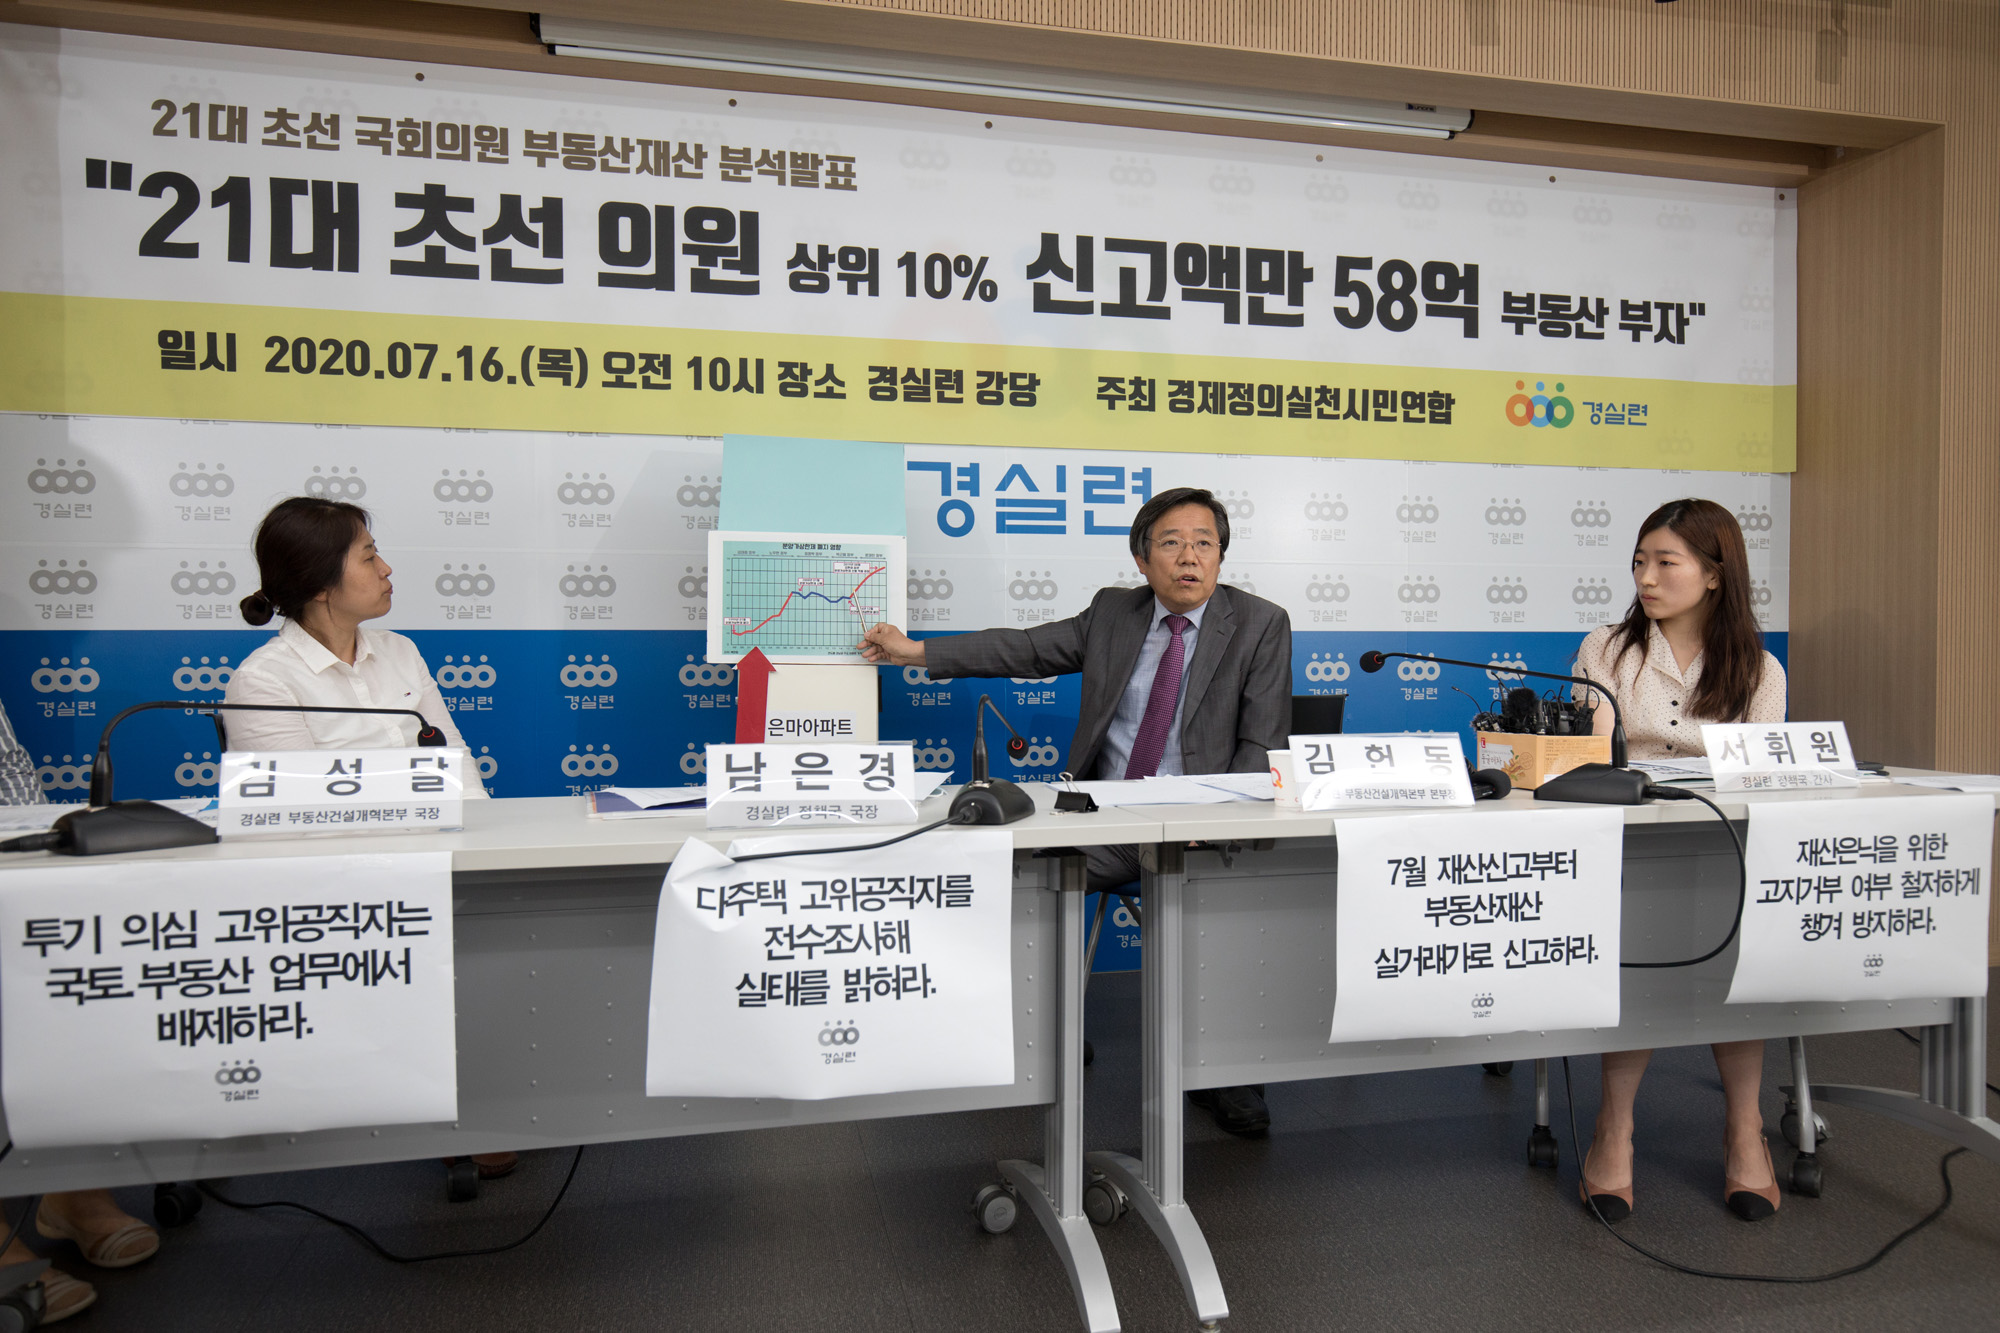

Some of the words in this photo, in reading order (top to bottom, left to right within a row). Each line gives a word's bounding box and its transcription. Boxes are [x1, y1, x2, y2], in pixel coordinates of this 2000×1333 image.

[150, 98, 249, 145] 21대
[261, 107, 343, 153] 초선
[354, 115, 510, 166] 국회의원
[522, 129, 708, 180] 부동산재산
[718, 145, 858, 192] 분석발표
[85, 157, 360, 274] "21대
[390, 182, 565, 285] 초선
[597, 200, 760, 296] 의원
[786, 241, 881, 297] 상위
[897, 250, 999, 303] 10%
[1025, 231, 1315, 329] 신고액만
[1333, 254, 1480, 340] 58억
[1500, 290, 1610, 341] 부동산
[1617, 298, 1706, 345] 부자"
[157, 328, 238, 373] 일시
[263, 334, 589, 388] 2020.07.16.(목)
[601, 350, 673, 391] 오전
[686, 356, 765, 396] 10시
[777, 361, 848, 400] 장소
[867, 364, 965, 405] 경실련
[975, 371, 1041, 408] 강당
[1096, 376, 1156, 414] 주최
[1167, 379, 1456, 425] 경제정의실천시민연합
[1581, 401, 1649, 427] 경실련
[907, 461, 1153, 538] 경실련
[33, 503, 93, 519] 경실련
[174, 505, 231, 521] 경실련
[438, 511, 490, 526] 경실련
[562, 513, 611, 528] 경실련
[1308, 528, 1346, 541] 경실련
[1400, 530, 1436, 543] 경실련
[1488, 532, 1524, 545] 경실련
[1574, 534, 1609, 546] 경실련
[35, 603, 94, 620] 경실련
[176, 604, 232, 620] 경실련
[440, 604, 492, 620] 경실련
[563, 605, 613, 620] 경실련
[907, 607, 951, 621] 경실련
[1012, 607, 1055, 621] 경실련
[1309, 610, 1347, 622] 경실련
[1401, 610, 1437, 623] 경실련
[1489, 611, 1525, 623] 경실련
[1575, 611, 1610, 624] 경실련
[683, 694, 731, 709] 경실련
[907, 691, 951, 706] 경실련
[1013, 691, 1056, 705] 경실련
[1401, 687, 1437, 700] 경실련
[37, 701, 96, 717] 경실련
[444, 696, 493, 711] 경실련
[565, 695, 614, 710] 경실련
[768, 718, 853, 738] 은마아파트
[1742, 776, 1772, 788] 경실련
[1813, 774, 1833, 786] 간사
[1345, 788, 1426, 800] 부동산건설개혁본부
[1430, 788, 1457, 800] 본부장
[240, 812, 281, 826] 경실련
[288, 808, 408, 825] 부동산건설개혁본부
[415, 807, 441, 821] 국장
[746, 806, 789, 820] 경실련
[799, 805, 842, 819] 정책국
[850, 804, 879, 819] 국장
[1797, 834, 1899, 867] 재산은닉을
[1907, 832, 1949, 862] 위한
[1387, 855, 1427, 888] 7월
[1437, 848, 1578, 885] 재산신고부터
[1756, 875, 1843, 905] 고지거부
[1851, 872, 1893, 901] 여부
[1901, 867, 1981, 899] 철저하게
[696, 879, 788, 919] 다주택
[800, 874, 974, 913] 고위공직자를
[1424, 890, 1543, 927] 부동산재산
[21, 914, 103, 958] 투기
[120, 909, 198, 951] 의심
[215, 899, 433, 944] 고위공직자는
[1800, 911, 1842, 942] 챙겨
[1852, 906, 1937, 939] 방지하라.
[764, 919, 912, 961] 전수조사해
[1374, 941, 1495, 979] 실거래가로
[1503, 933, 1599, 970] 신고하라.
[269, 947, 412, 993] 업무에서
[735, 969, 831, 1008] 실태를
[844, 962, 937, 1003] 밝혀라.
[157, 1000, 314, 1047] 배제하라.
[821, 1051, 857, 1065] 경실련
[220, 1089, 261, 1102] 경실련
